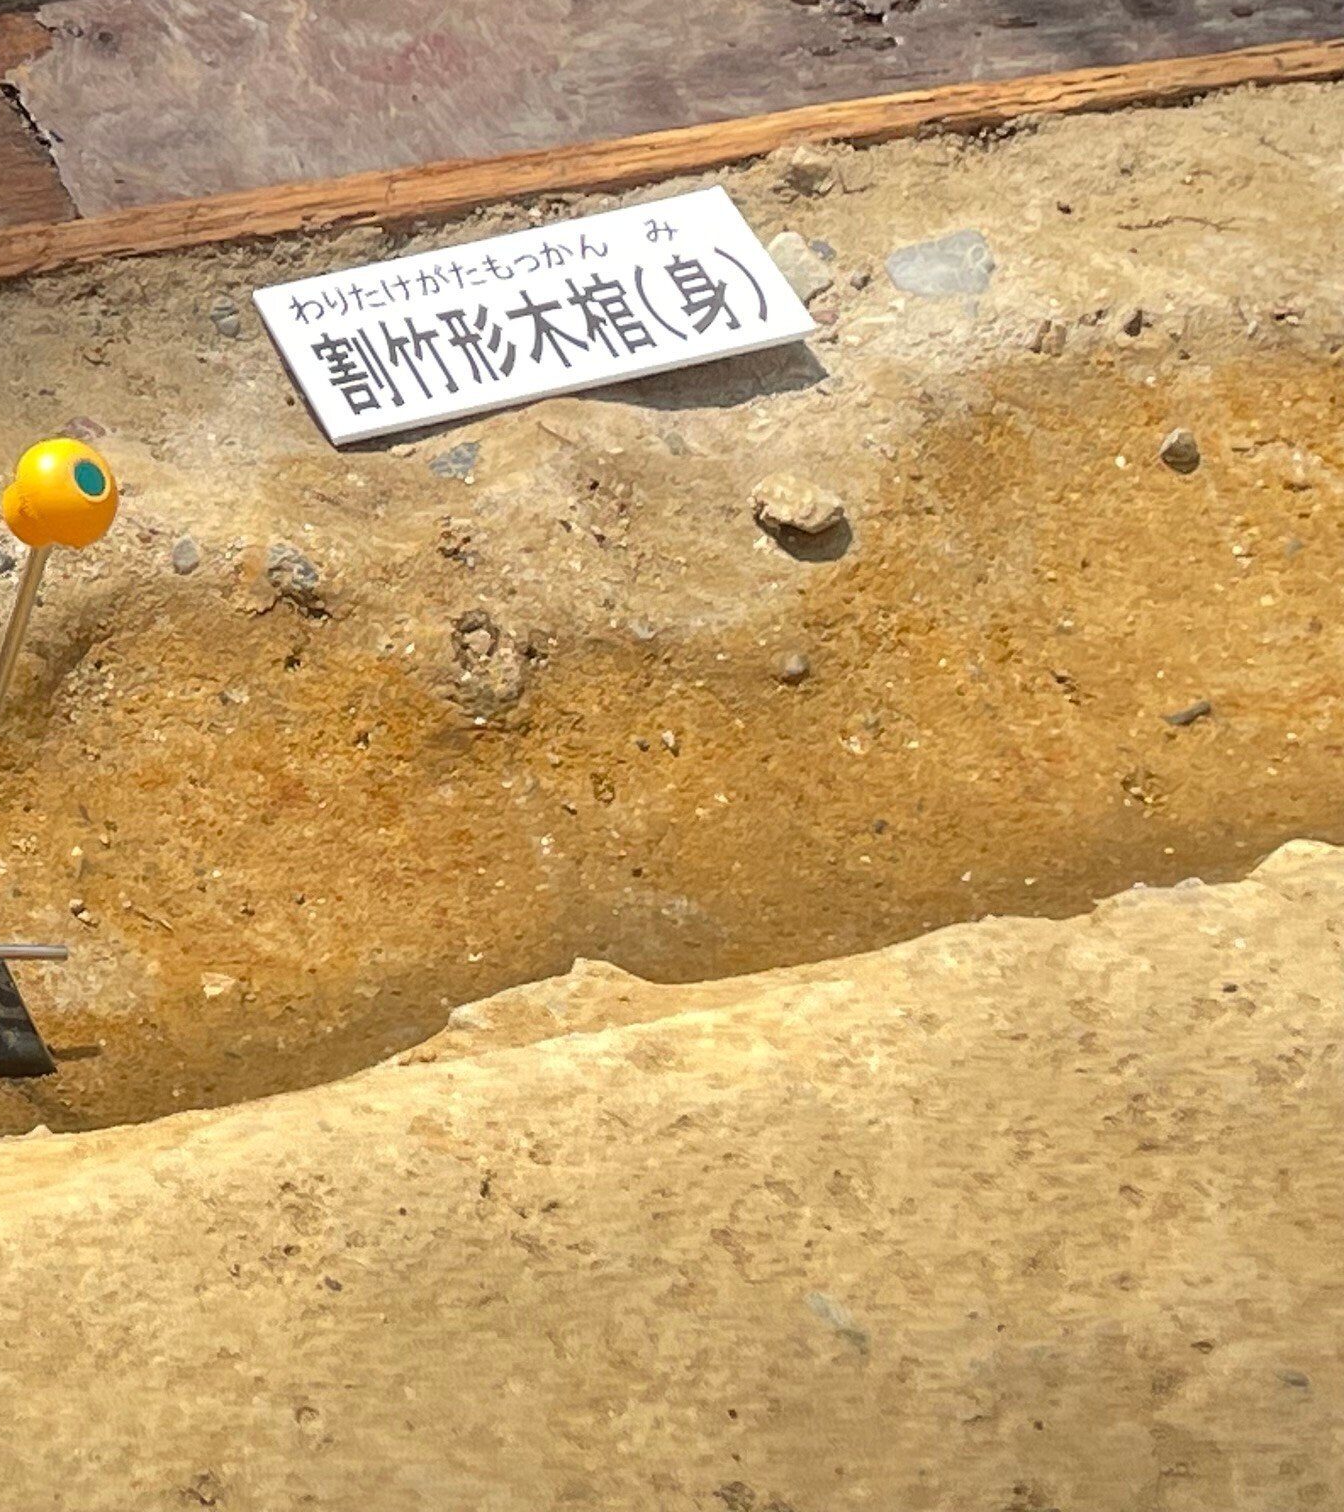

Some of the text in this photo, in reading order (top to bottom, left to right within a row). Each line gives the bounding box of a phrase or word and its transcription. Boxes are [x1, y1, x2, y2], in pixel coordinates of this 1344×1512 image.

[310, 246, 769, 416] 割竹形木棺(身)
